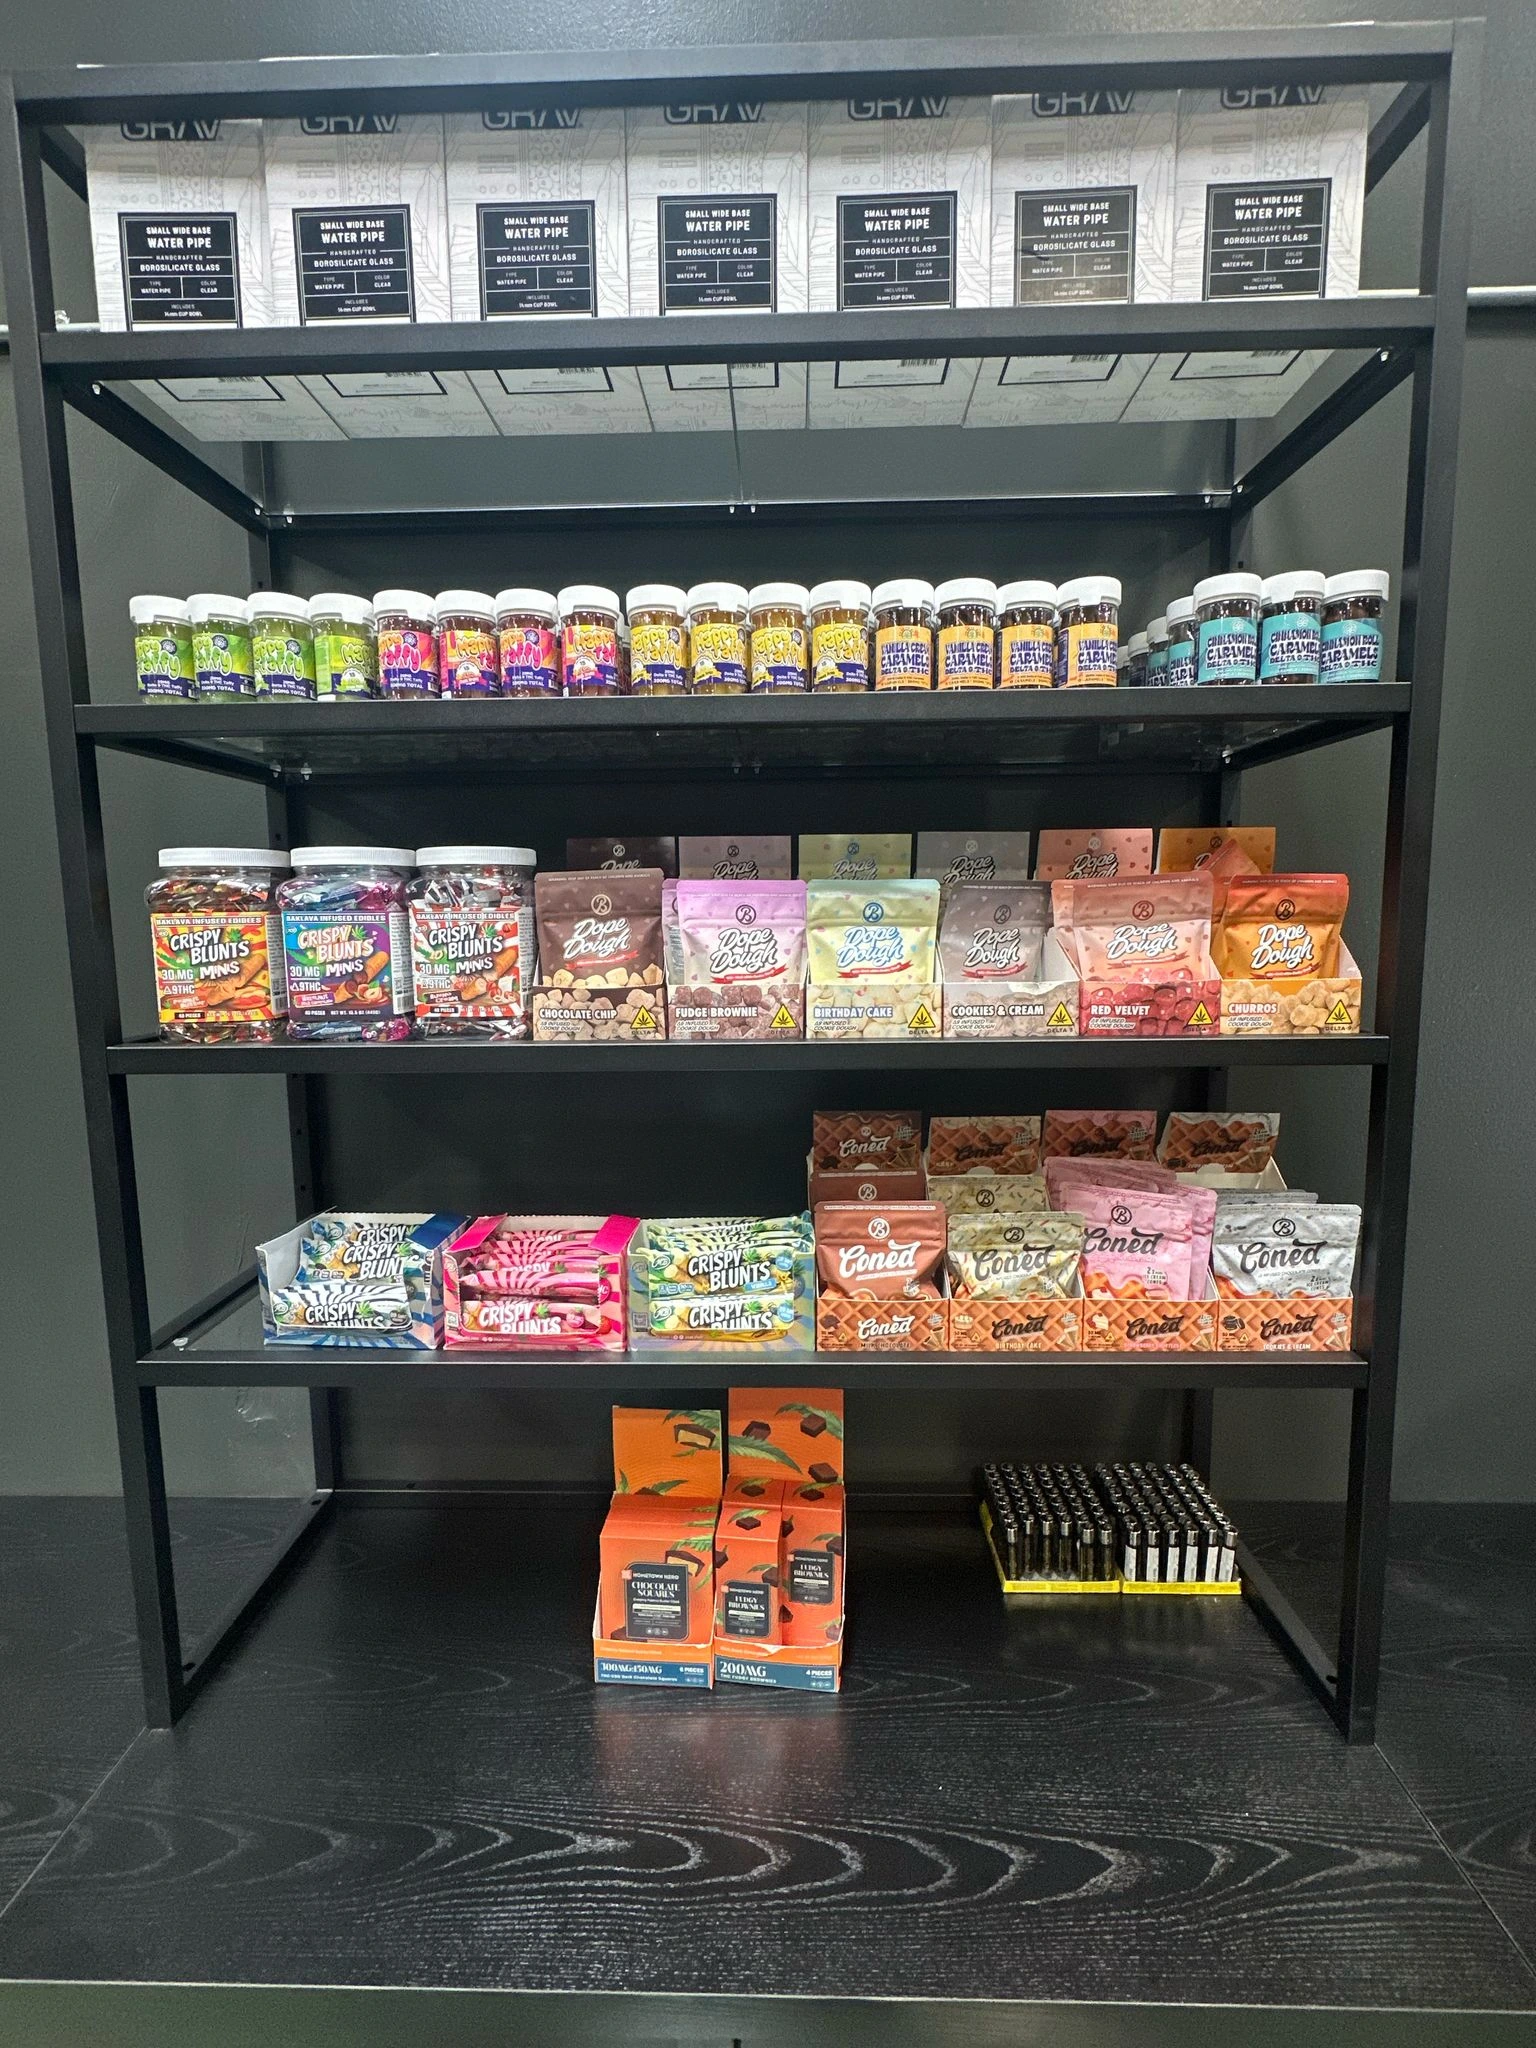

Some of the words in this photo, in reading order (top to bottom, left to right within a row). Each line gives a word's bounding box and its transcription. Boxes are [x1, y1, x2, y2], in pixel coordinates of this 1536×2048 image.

[1043, 205, 1068, 213] SMALL
[1070, 204, 1088, 212] WIDE
[1235, 198, 1260, 206] SMALL
[1262, 197, 1281, 205] WIDE
[1283, 195, 1303, 203] BASE
[504, 217, 528, 225] SMALL
[550, 216, 569, 224] BASE
[685, 210, 710, 218] SMALL
[732, 209, 750, 217] BASE
[864, 209, 888, 217] SMALL
[891, 208, 909, 216] WIDE
[1043, 216, 1080, 227] WATER
[1083, 214, 1109, 224] PIPE
[1235, 209, 1273, 221] WATER
[1276, 207, 1302, 218] PIPE
[146, 227, 170, 235] SMALL
[320, 221, 344, 229] SMALL
[366, 220, 384, 228] BASE
[505, 228, 540, 239] WATER
[545, 227, 569, 238] PIPE
[686, 221, 722, 232] WATER
[725, 221, 750, 230] PIPE
[865, 220, 901, 232] WATER
[905, 219, 930, 230] PIPE
[148, 238, 180, 248] WATER
[184, 238, 211, 248] PIPE
[322, 232, 357, 244] WATER
[361, 232, 385, 242] PIPE
[1034, 242, 1088, 250] BOROSILICATE
[1091, 240, 1115, 249] GLASS
[1224, 236, 1280, 245] BOROSILICATE
[1282, 234, 1308, 243] GLASS
[497, 254, 549, 263] BOROSILICATE
[552, 254, 576, 262] GLASS
[677, 248, 730, 256] BOROSILICATE
[733, 247, 757, 255] GLASS
[856, 246, 910, 255] BOROSILICATE
[912, 245, 937, 253] GLASS
[314, 259, 366, 267] BOROSILICATE
[1363, 635, 1379, 646] ROLL
[1321, 647, 1378, 664] CARAMELS
[713, 860, 758, 877] Dope
[833, 858, 877, 876] Dope
[951, 855, 995, 874] Dope
[1072, 853, 1118, 872] Dope
[298, 926, 351, 949] CRISPY
[429, 923, 476, 945] CRISPY
[574, 918, 629, 940] Dope
[843, 926, 901, 947] Dope
[973, 927, 1021, 947] Dope
[1115, 923, 1171, 941] Dope
[1259, 924, 1306, 948] Dope
[170, 929, 221, 951] CRISPY
[449, 936, 502, 960] BLUNTS
[563, 929, 632, 960] Dough
[719, 928, 774, 951] Dope
[1106, 930, 1178, 960] Dough
[191, 941, 250, 965] BLUNTS
[317, 939, 374, 963] BLUNTS
[710, 942, 778, 974] Dough
[836, 939, 904, 968] Dough
[963, 940, 1022, 969] Dough
[1251, 940, 1314, 969] Dough
[162, 970, 174, 980] 30
[177, 969, 193, 979] MG
[200, 961, 240, 980] MINIS
[290, 967, 302, 977] 30
[305, 967, 320, 977] MG
[326, 959, 364, 977] MINIS
[420, 964, 432, 974] 30
[434, 964, 449, 974] MG
[455, 957, 493, 974] MINIS
[539, 1009, 592, 1019] CHOCOLATE
[594, 1009, 618, 1019] CHIP
[675, 1007, 707, 1017] FUDGE
[710, 1007, 757, 1017] BROWNIE
[814, 1007, 864, 1018] BIRTHDAY
[866, 1007, 892, 1017] CAKE
[952, 1006, 995, 1016] COOKIES
[997, 1005, 1006, 1016] &
[1009, 1005, 1044, 1015] CREAM
[1091, 1005, 1111, 1014] RED
[1114, 1005, 1150, 1015] VELVET
[1228, 1004, 1277, 1013] CHURROS
[839, 1135, 891, 1157] Coned
[357, 1226, 407, 1246] CRISPY
[1085, 1227, 1164, 1255] Coned
[343, 1242, 397, 1264] CRISPY
[839, 1239, 921, 1278] Coned
[1238, 1238, 1328, 1274] Coned
[688, 1250, 744, 1277] CRISPY
[972, 1244, 1055, 1281] Coned
[710, 1262, 771, 1292] BLUNTS
[304, 1301, 357, 1324] CRISPY
[479, 1302, 534, 1327] CRISPY
[689, 1301, 745, 1328] CRISPY
[857, 1315, 915, 1340] Coned
[991, 1314, 1048, 1340] Coned
[1126, 1313, 1185, 1340] Coned
[1260, 1313, 1318, 1340] Coned
[720, 1662, 766, 1677] 200MG
